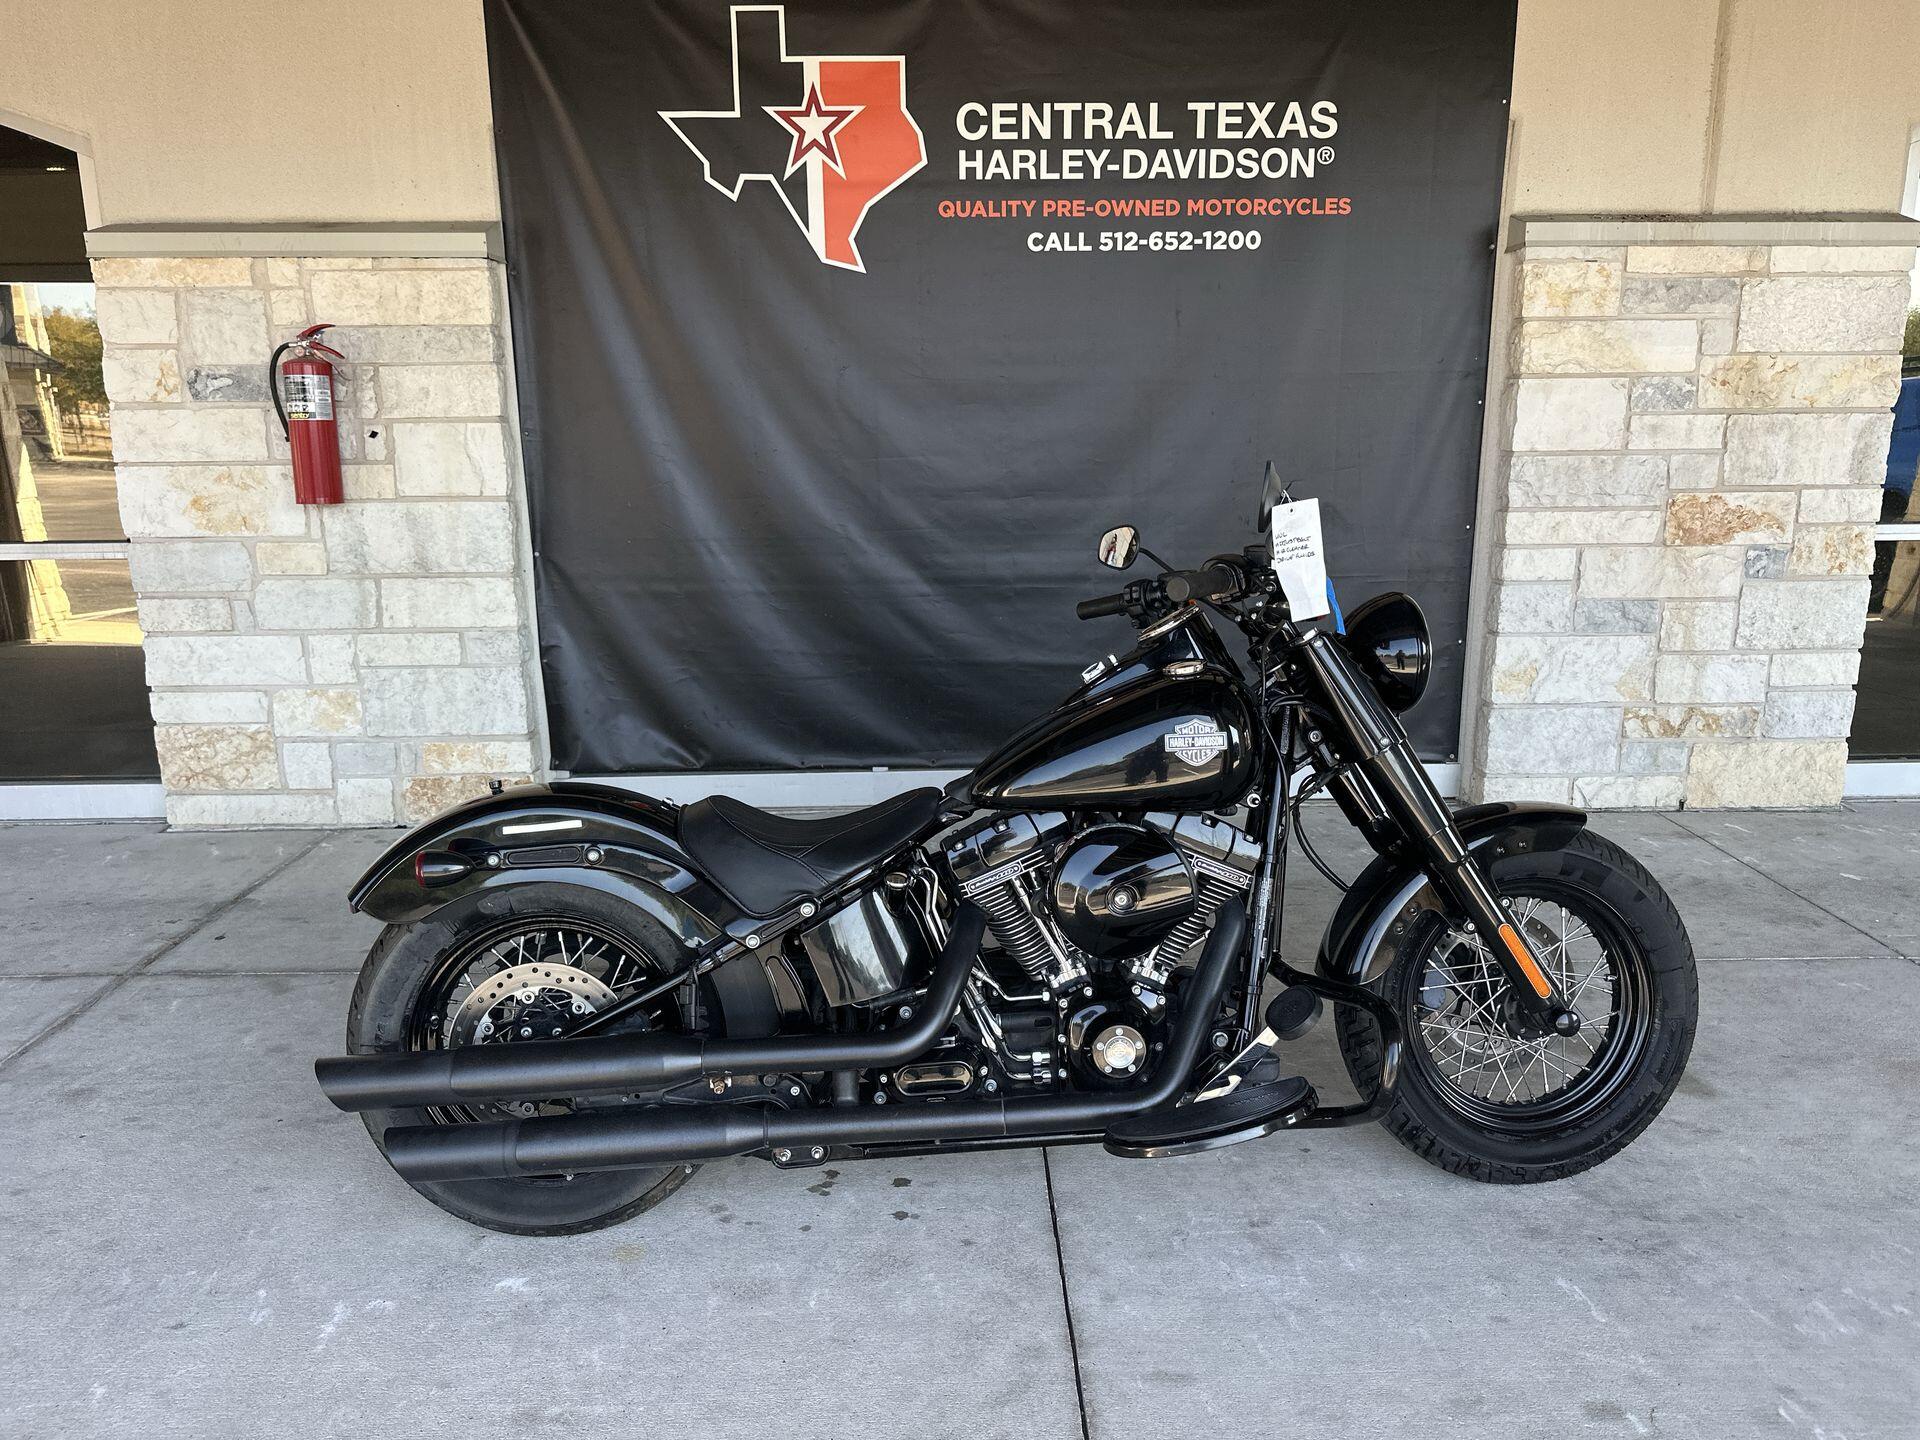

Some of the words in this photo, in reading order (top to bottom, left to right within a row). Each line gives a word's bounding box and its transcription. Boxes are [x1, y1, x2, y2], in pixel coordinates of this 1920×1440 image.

[956, 102, 1173, 140] CENTRAL
[1188, 101, 1338, 139] TEXAS
[938, 200, 1036, 218] QUALITY
[1042, 199, 1181, 217] PRE-OWNED
[1188, 198, 1352, 216] MOTORCYCLES
[1027, 231, 1092, 252] CALL
[1099, 230, 1261, 251] 512-652-1200
[1181, 724, 1211, 734] MOTOR
[1170, 736, 1223, 748] HARLEY-DAVIDSON
[1183, 750, 1211, 761] CYCLES
